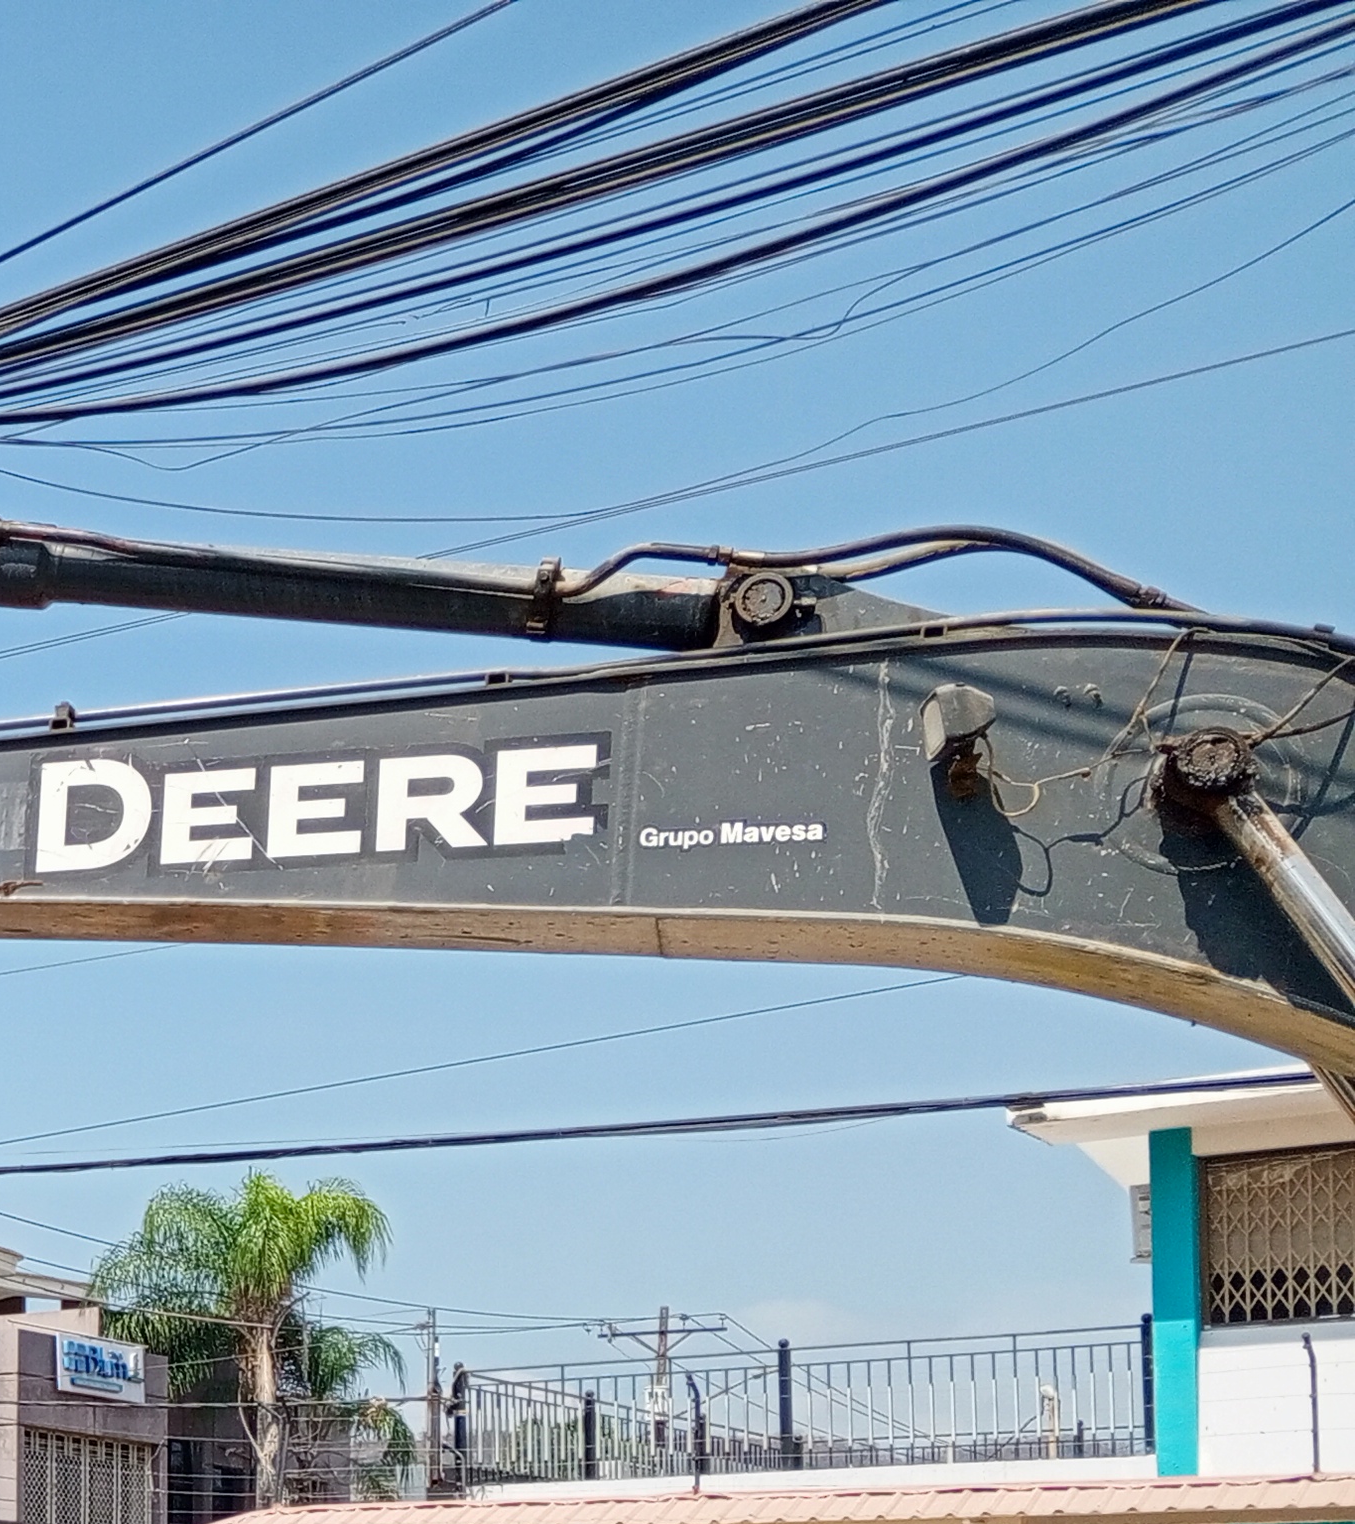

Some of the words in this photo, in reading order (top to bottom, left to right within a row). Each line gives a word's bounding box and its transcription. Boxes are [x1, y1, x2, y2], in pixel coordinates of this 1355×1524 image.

[35, 745, 597, 873] DEERE
[639, 827, 714, 849] Grupo
[721, 822, 825, 844] Mavesa
